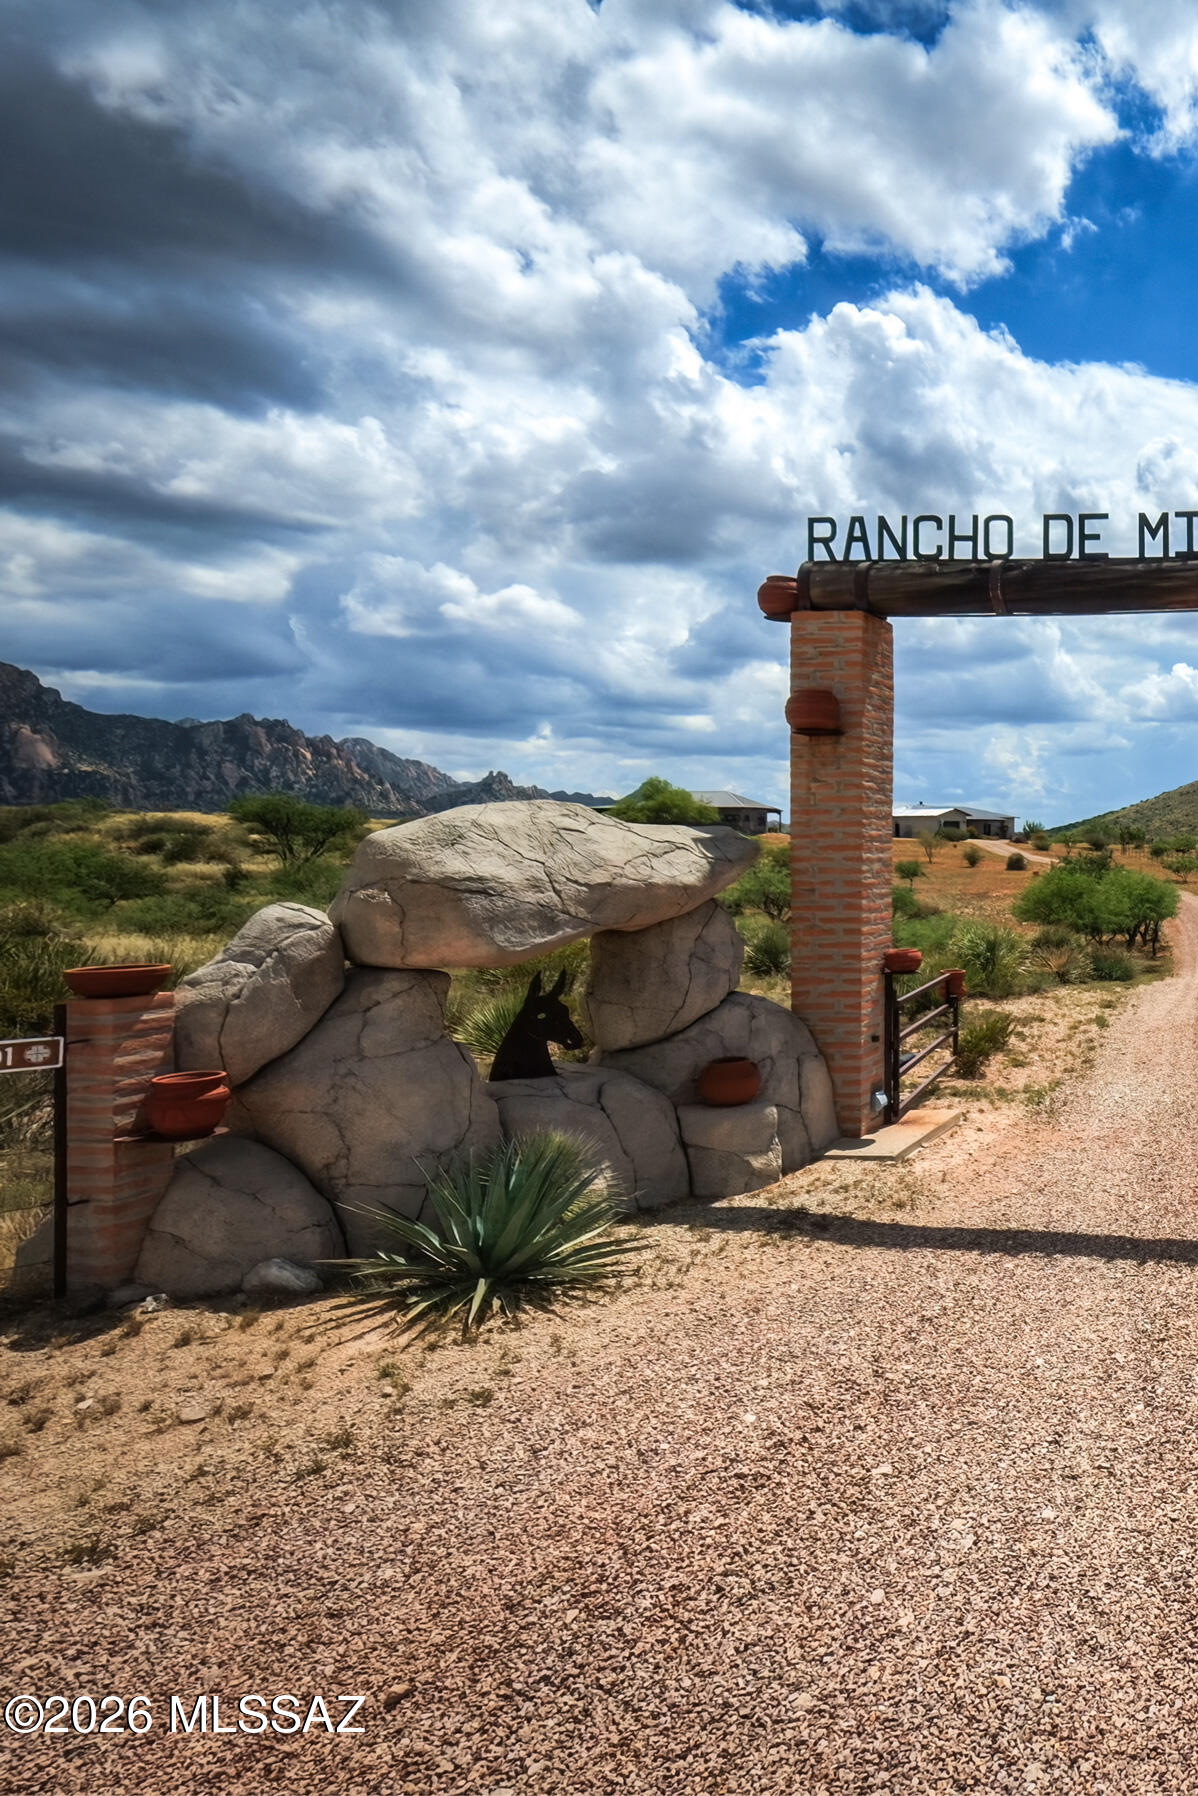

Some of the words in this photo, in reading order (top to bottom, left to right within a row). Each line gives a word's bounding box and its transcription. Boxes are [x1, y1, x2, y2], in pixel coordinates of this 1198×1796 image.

[808, 514, 1013, 561] RANCHO
[1043, 513, 1109, 560] DE
[0, 1046, 13, 1067] 1
